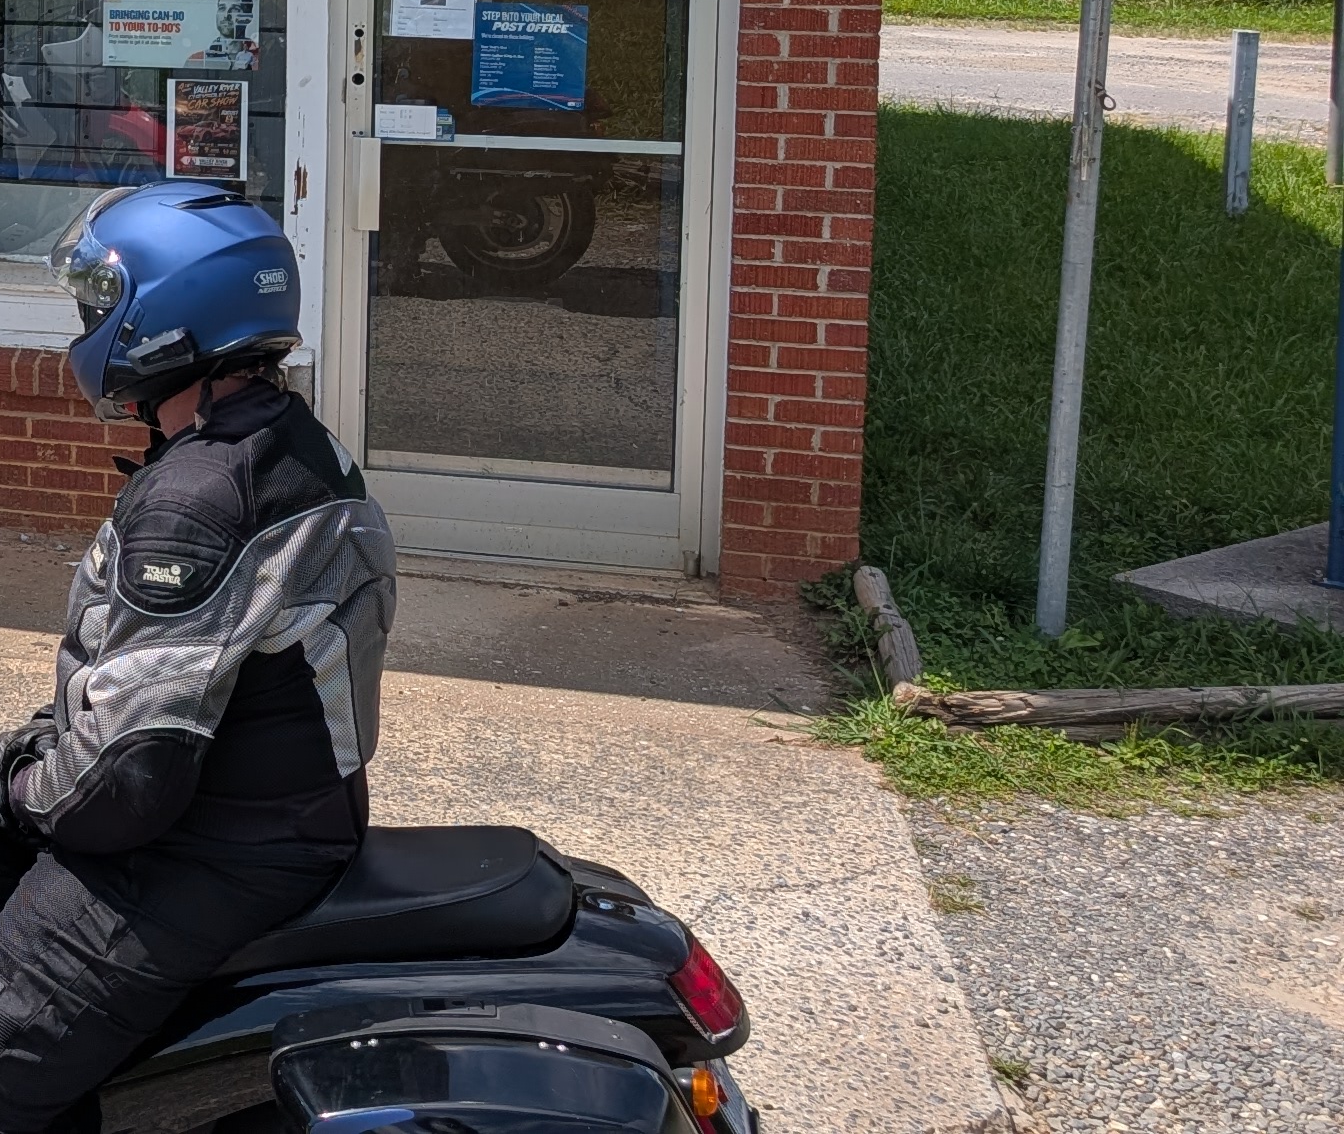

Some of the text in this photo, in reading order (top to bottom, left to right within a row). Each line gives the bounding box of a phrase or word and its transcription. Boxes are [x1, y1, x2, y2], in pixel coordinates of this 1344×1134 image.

[109, 10, 185, 21] BRINGING CAN-DO
[481, 11, 564, 23] STEP INTO YOUR LOCAL
[109, 22, 181, 33] TO YOUR TO-DO'S
[492, 22, 570, 33] POST OFFICE
[193, 85, 219, 93] VALLEY
[219, 83, 240, 92] RIVER
[187, 96, 238, 110] CAR SHOW
[259, 271, 285, 284] SHOEI
[143, 564, 171, 576] TOUR
[142, 572, 182, 586] MASTER
